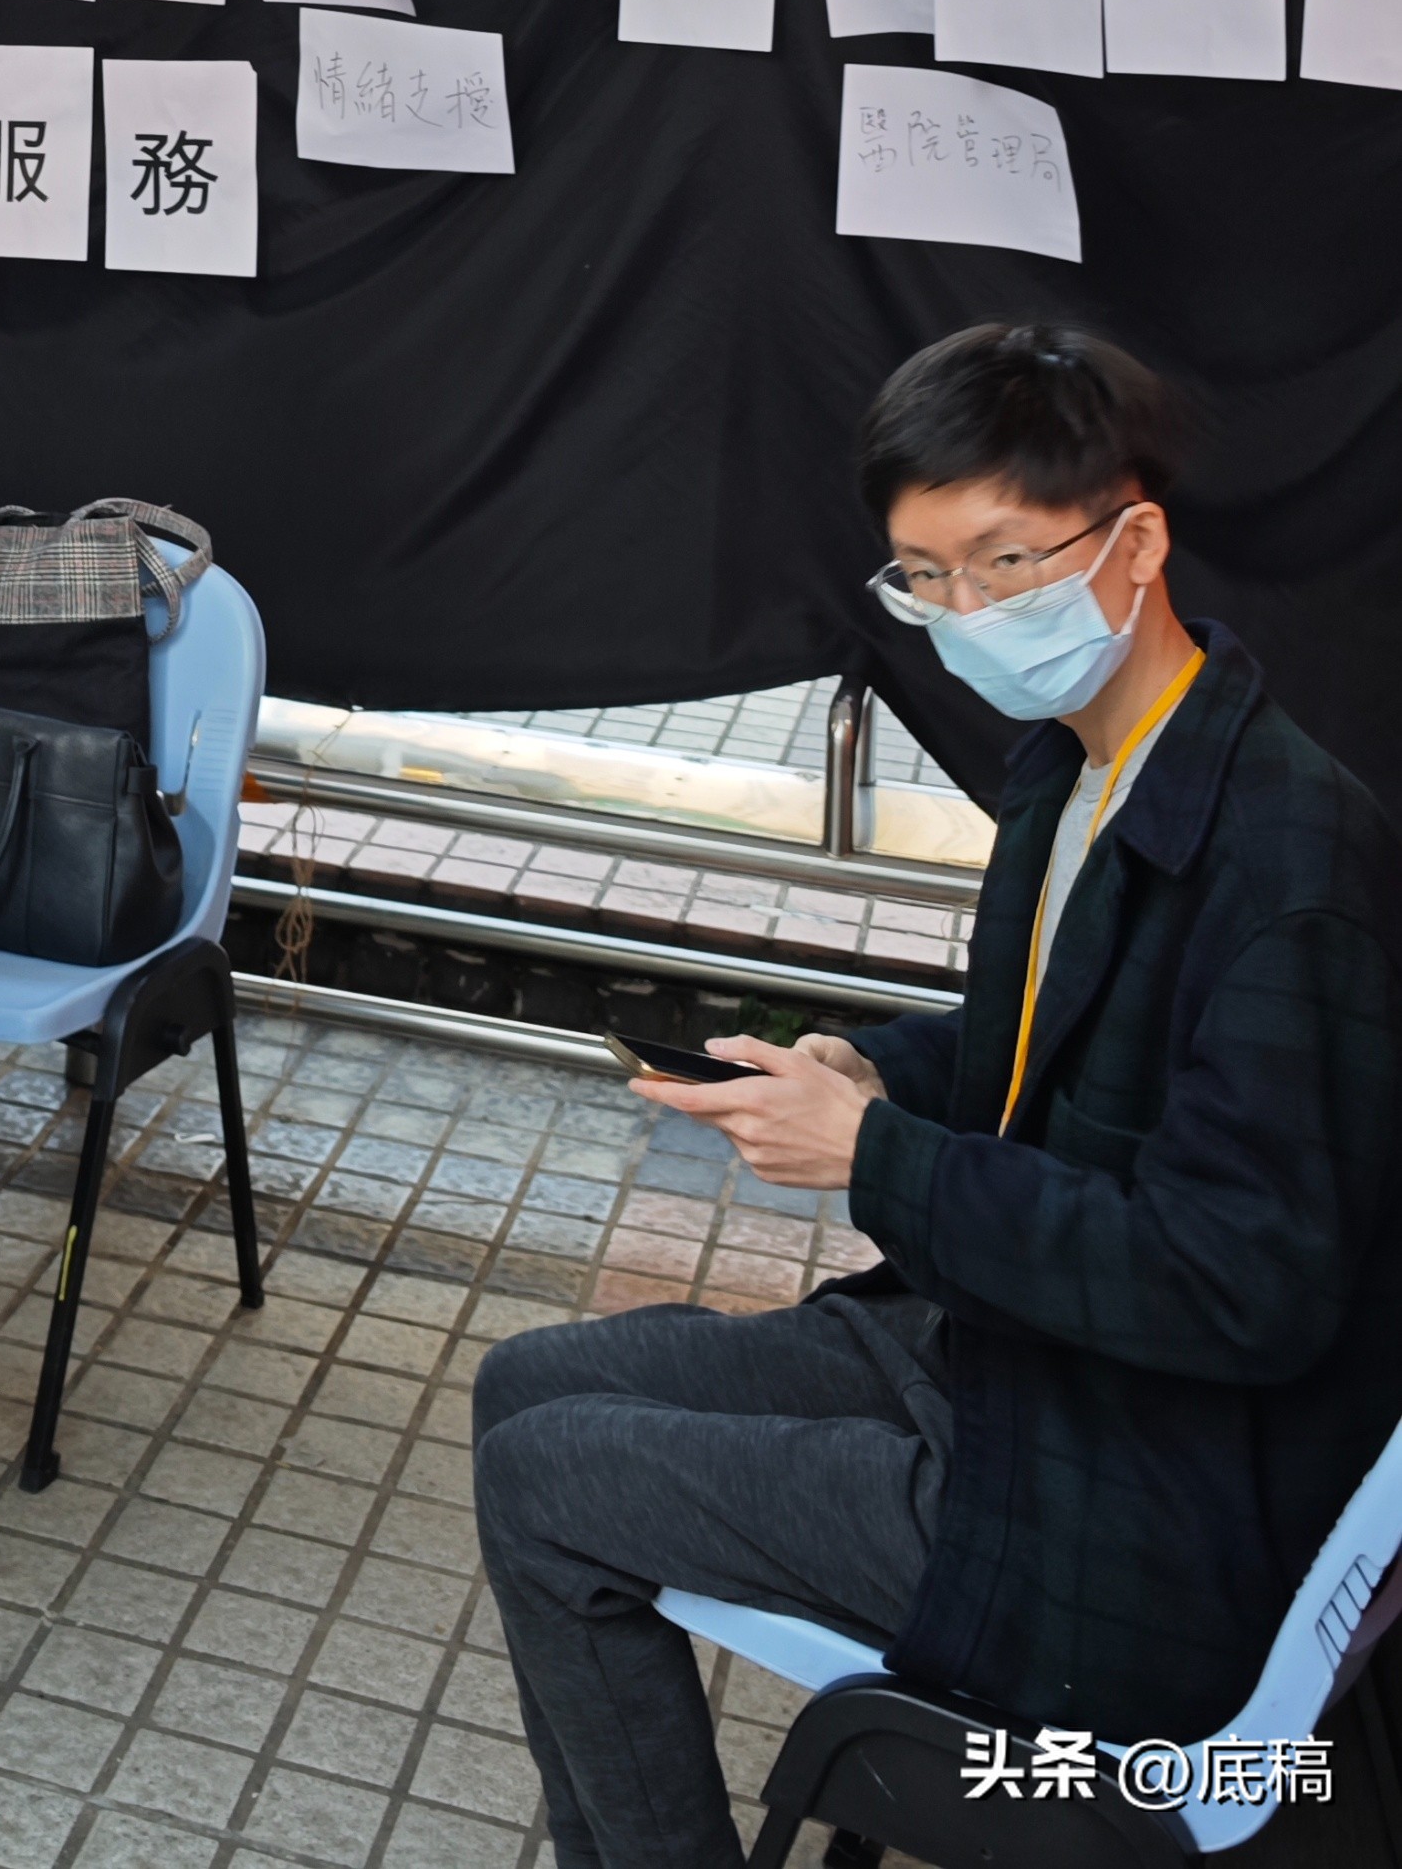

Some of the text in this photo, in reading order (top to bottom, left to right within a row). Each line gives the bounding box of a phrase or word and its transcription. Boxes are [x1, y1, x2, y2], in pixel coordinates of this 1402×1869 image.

[858, 107, 1061, 192] 醫院管理局
